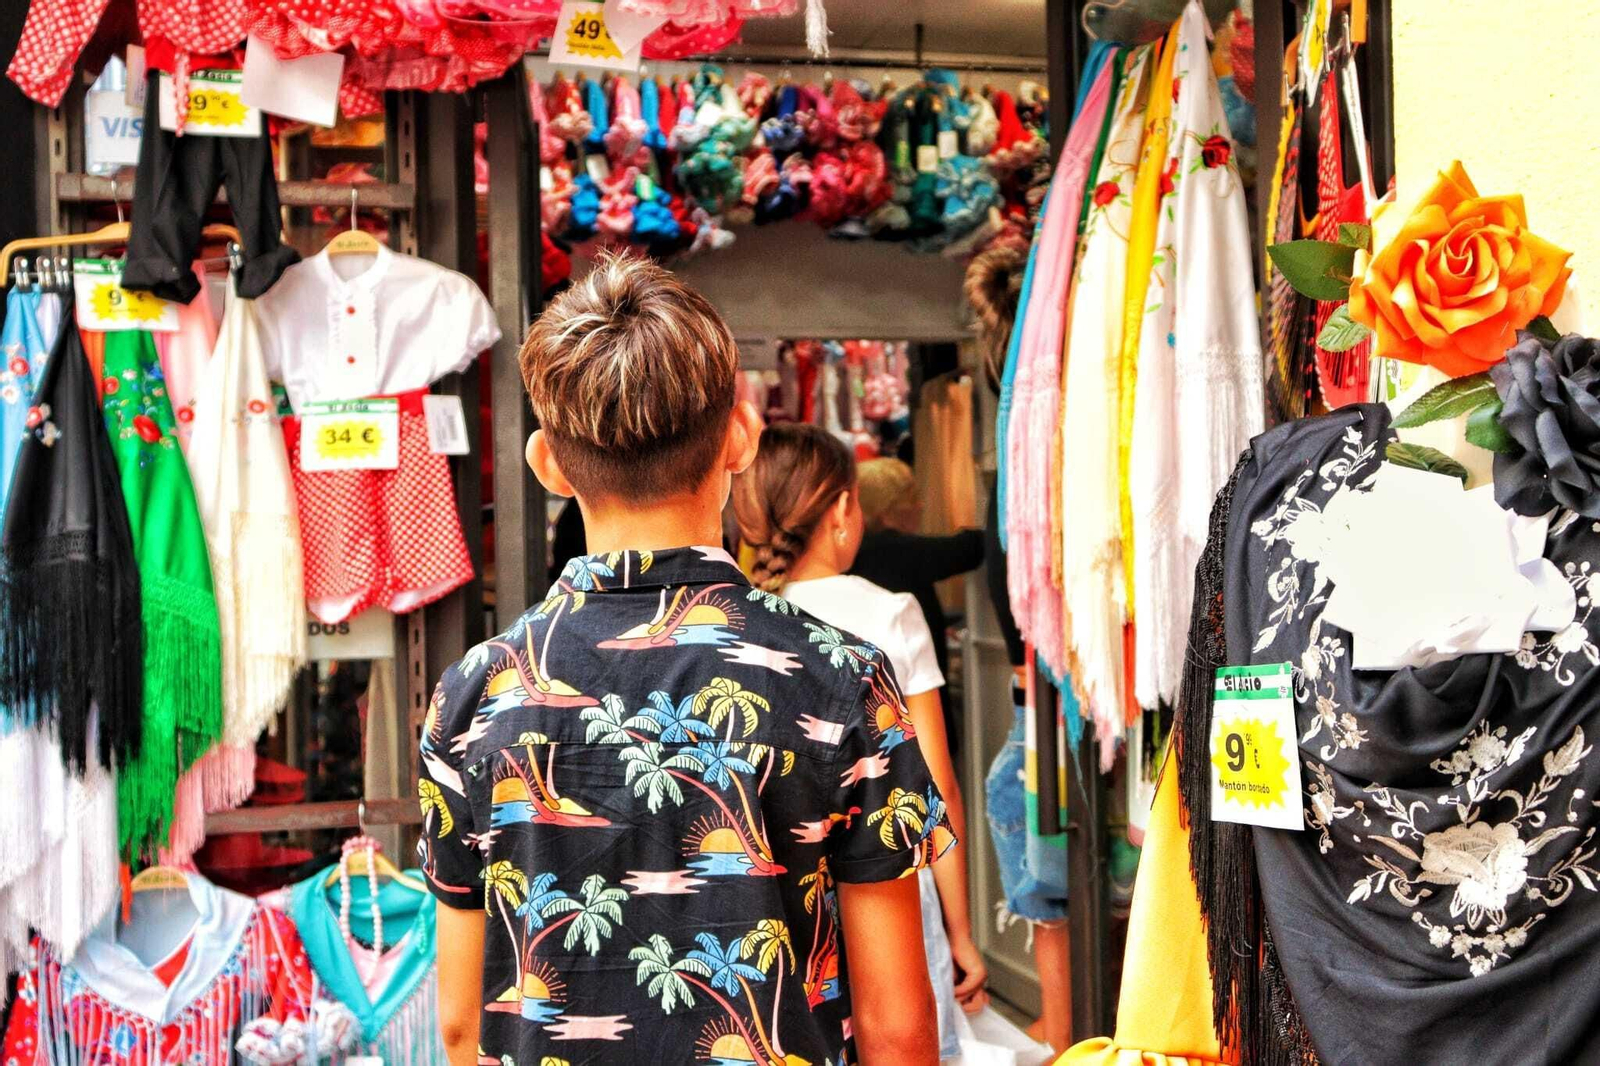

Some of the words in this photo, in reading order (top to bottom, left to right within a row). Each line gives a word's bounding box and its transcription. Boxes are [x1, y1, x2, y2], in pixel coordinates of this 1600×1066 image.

[574, 18, 601, 40] 49
[98, 116, 144, 138] VIS
[108, 289, 122, 306] 9
[325, 428, 352, 445] 34
[361, 427, 375, 444] €
